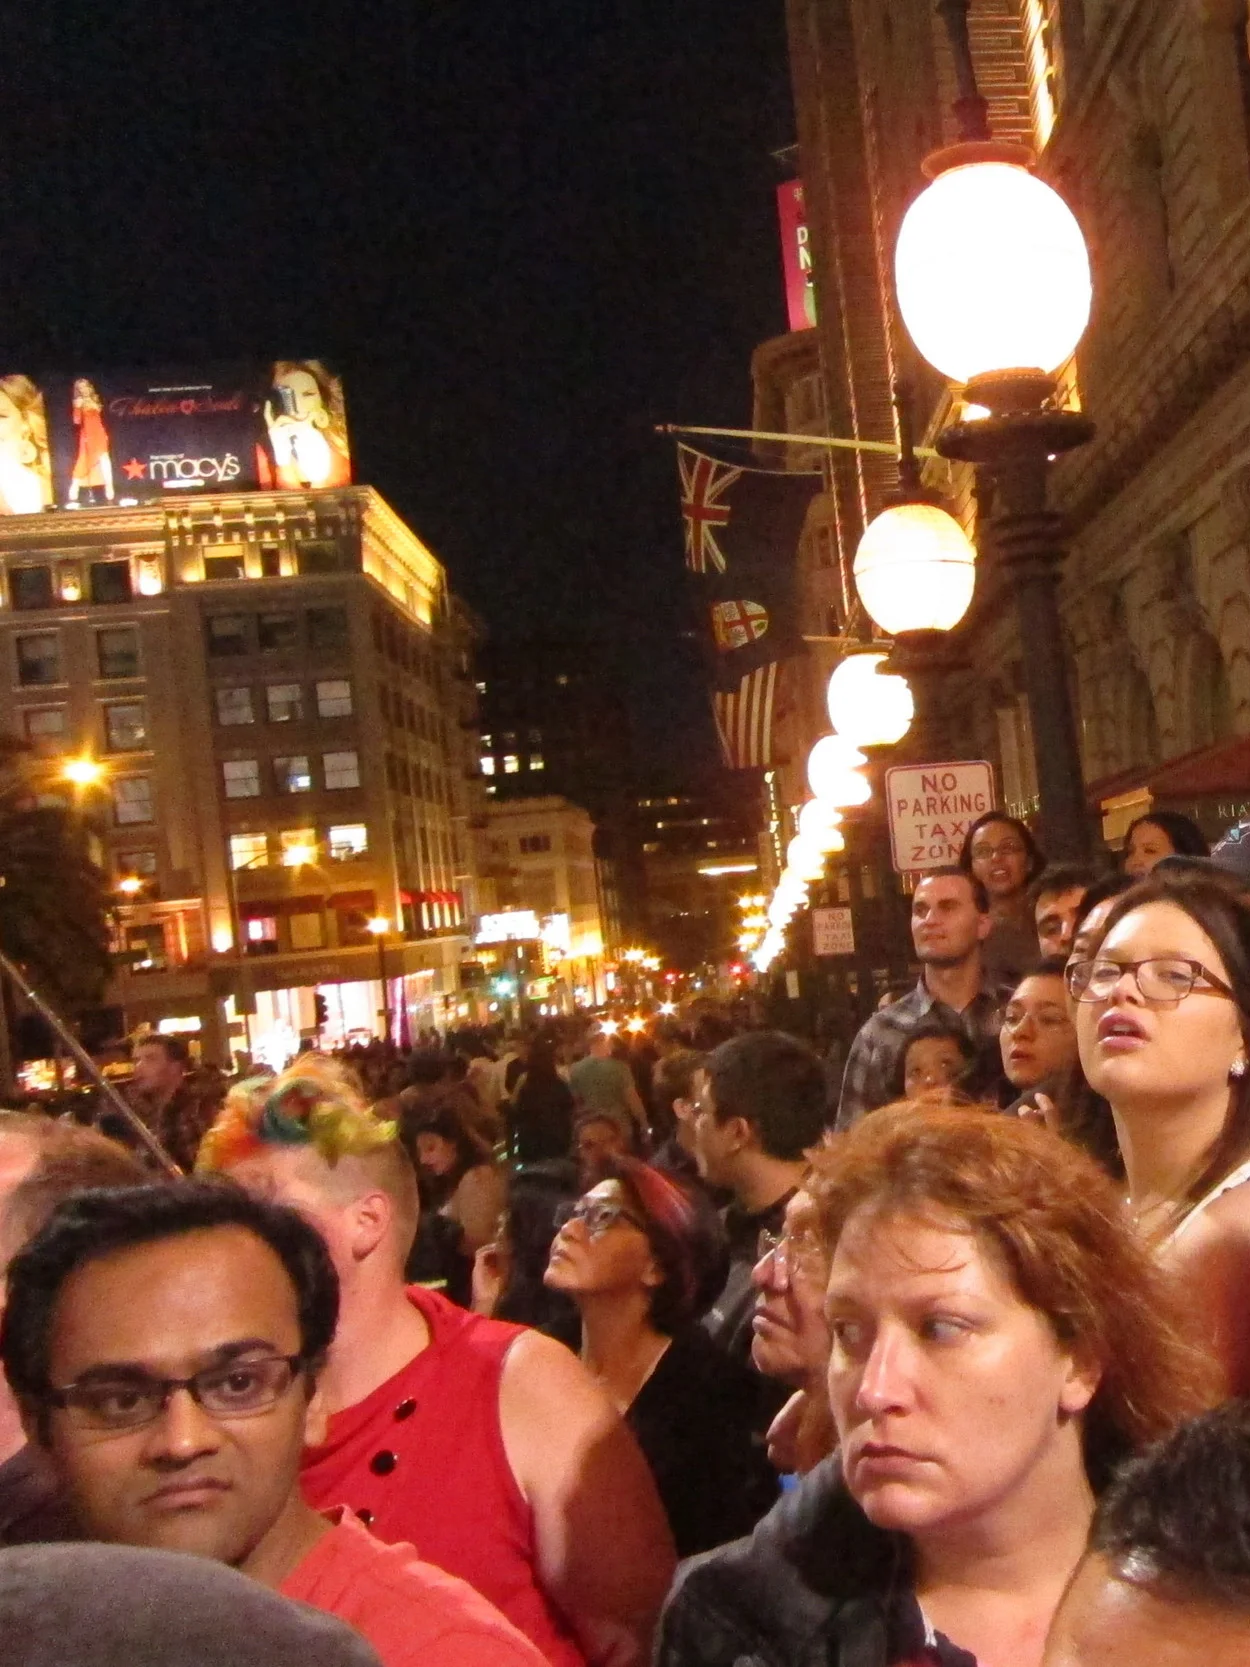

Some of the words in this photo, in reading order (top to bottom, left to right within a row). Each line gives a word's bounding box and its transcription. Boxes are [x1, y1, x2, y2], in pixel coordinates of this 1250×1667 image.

[150, 453, 240, 481] macy's
[921, 773, 957, 793] NO
[897, 793, 986, 818] PARKING
[911, 841, 961, 862] ZON
